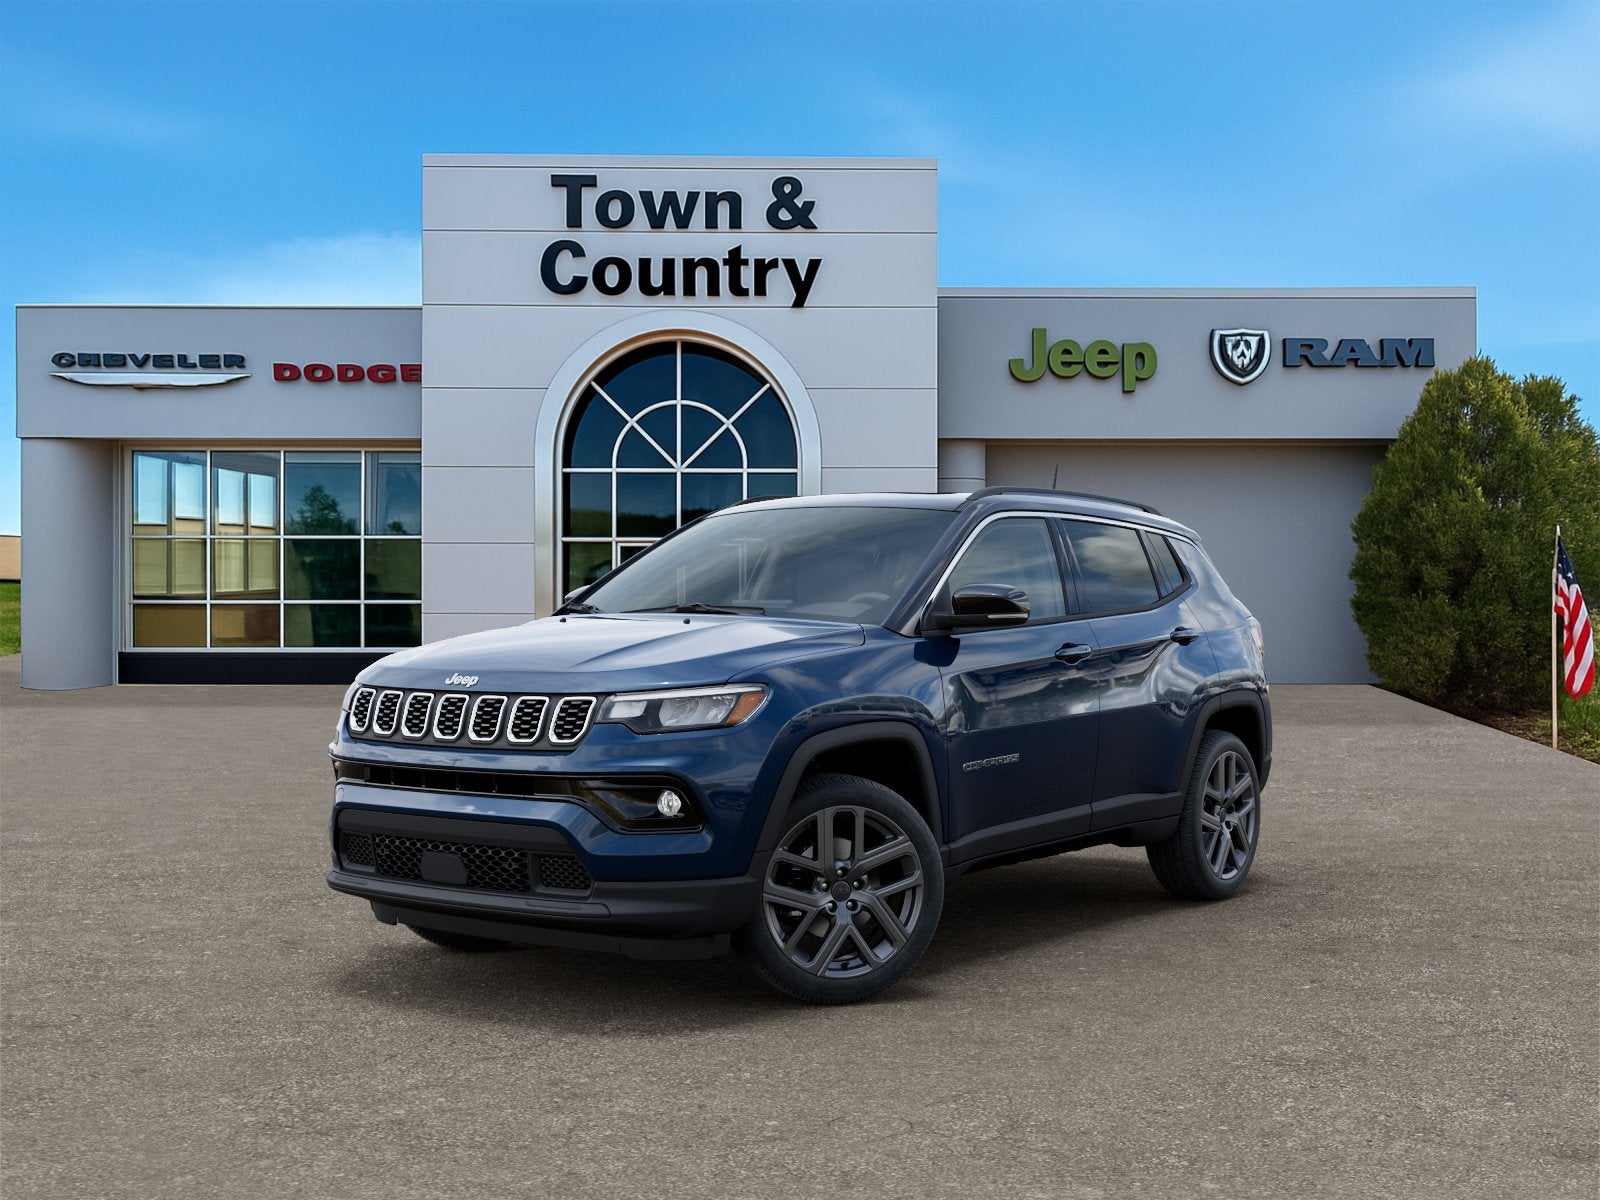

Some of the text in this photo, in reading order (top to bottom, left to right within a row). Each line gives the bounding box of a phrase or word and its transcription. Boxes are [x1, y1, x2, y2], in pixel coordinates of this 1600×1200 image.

[551, 174, 818, 230] Town &
[540, 239, 823, 308] Country
[272, 363, 422, 383] DODGE
[1009, 327, 1157, 393] Jeep
[1282, 337, 1435, 368] RAM
[444, 672, 479, 688] Jeep
